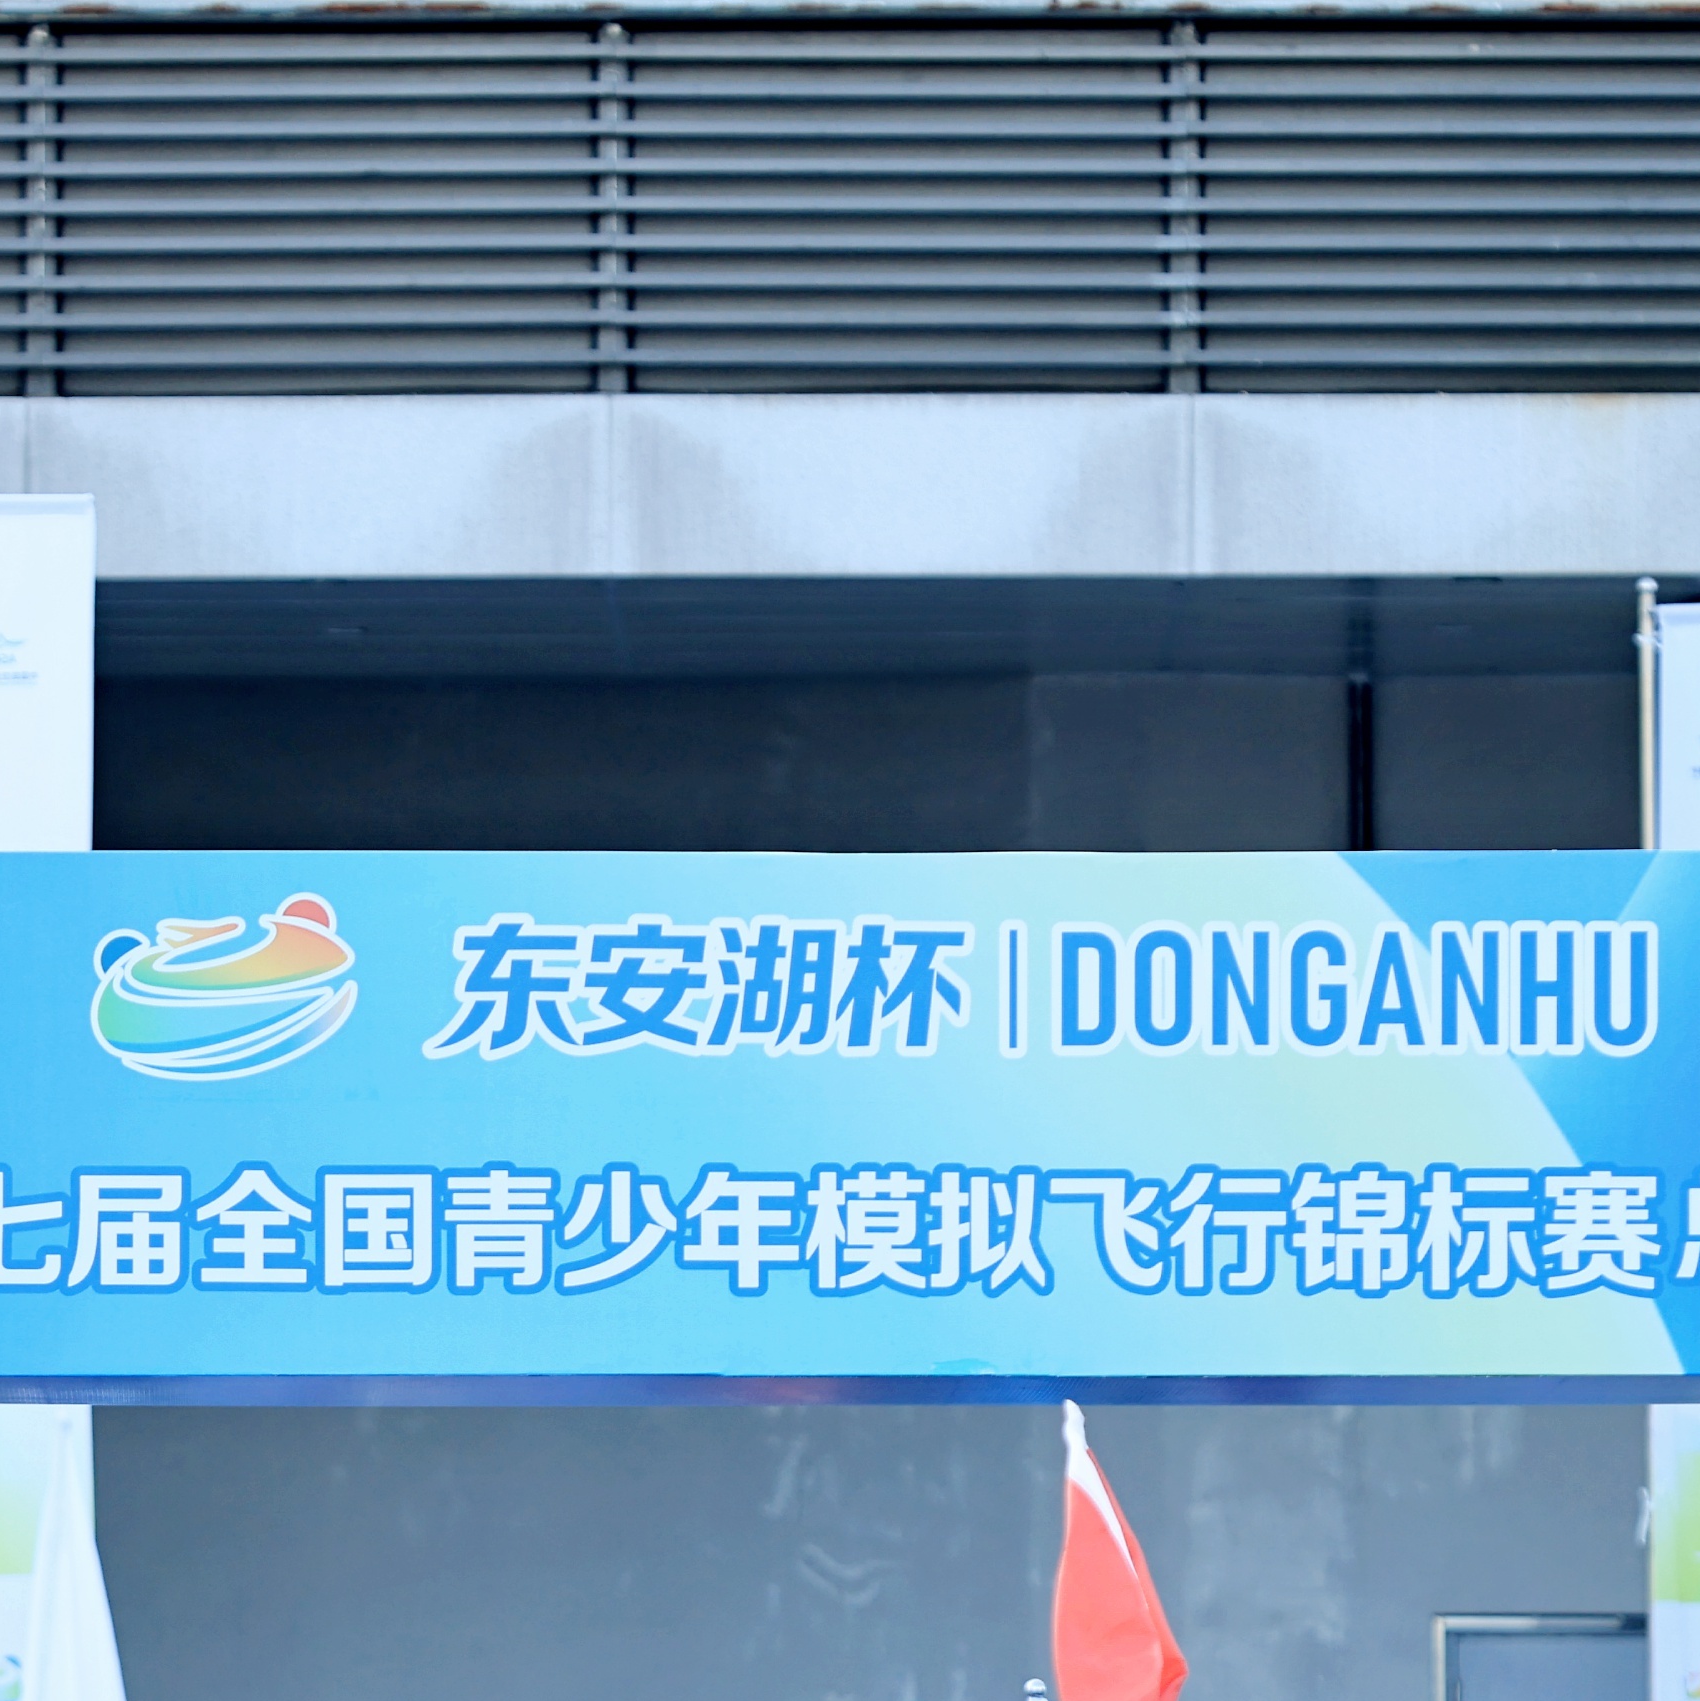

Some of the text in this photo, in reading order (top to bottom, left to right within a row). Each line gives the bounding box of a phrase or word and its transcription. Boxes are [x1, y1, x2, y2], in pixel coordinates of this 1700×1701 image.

[430, 920, 1652, 1052] 东安湖杯 DONGANHU
